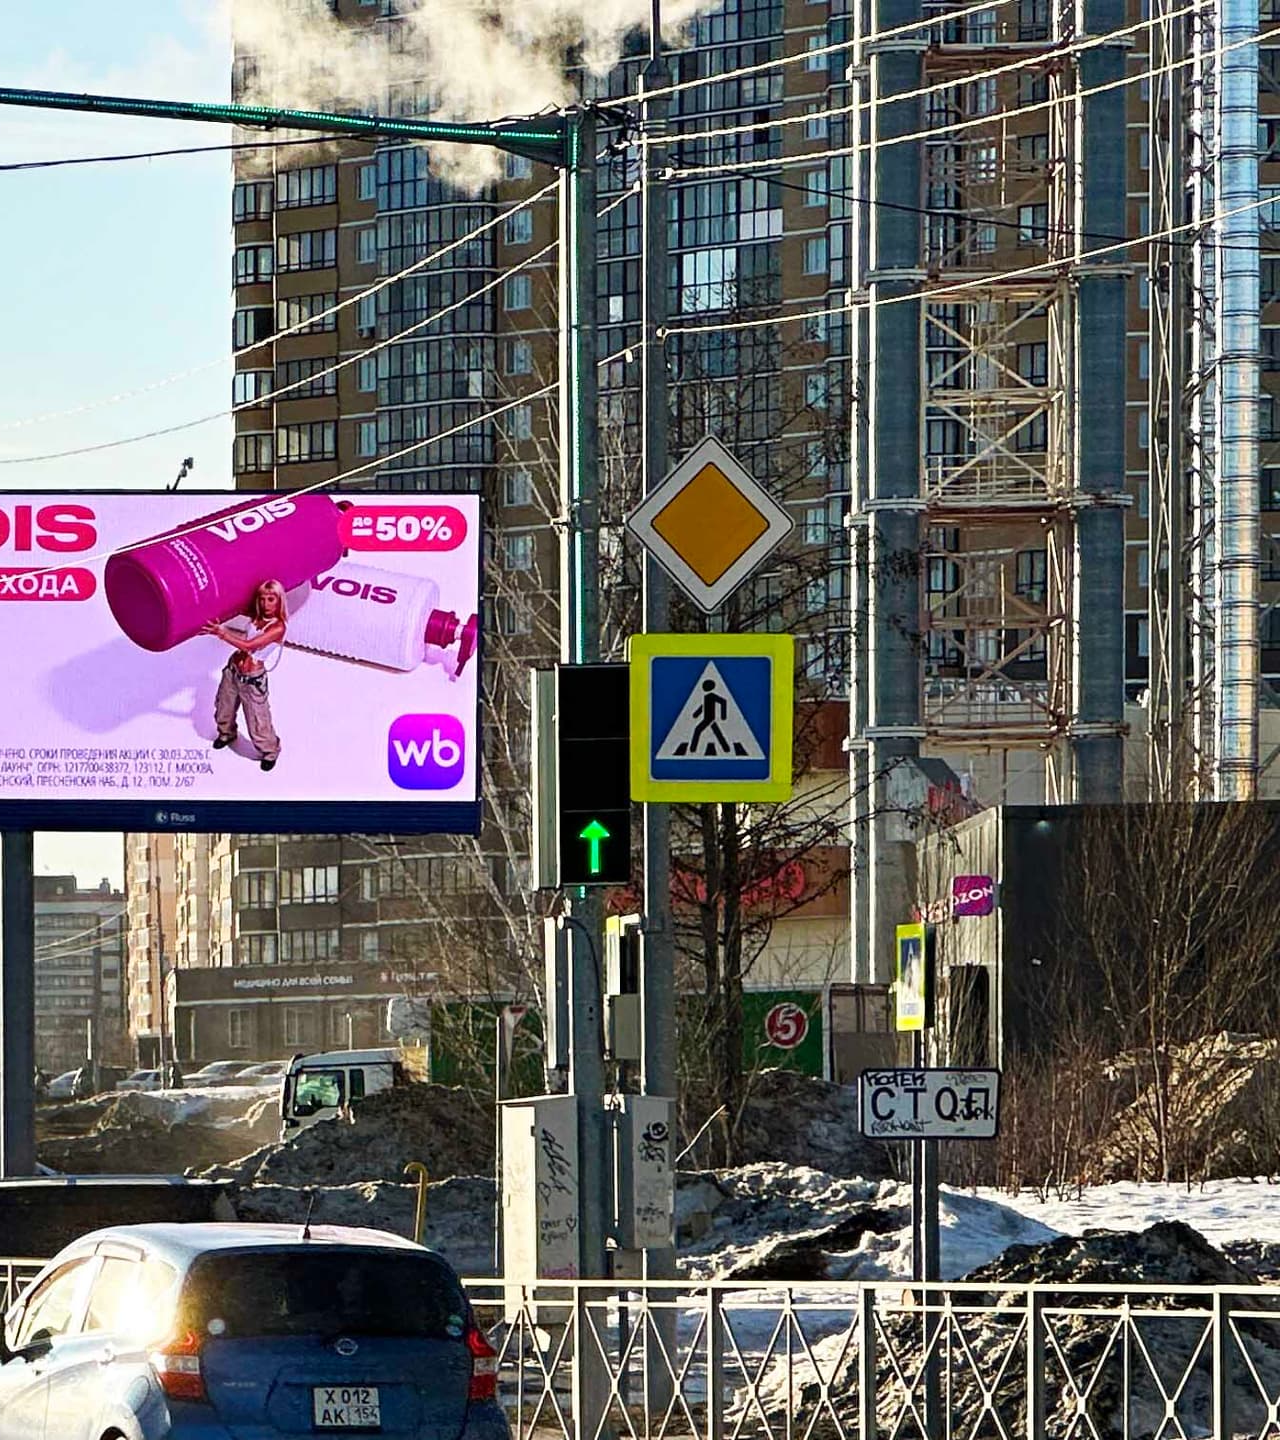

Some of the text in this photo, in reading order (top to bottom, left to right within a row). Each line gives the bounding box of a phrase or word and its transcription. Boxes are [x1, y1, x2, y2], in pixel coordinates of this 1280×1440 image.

[206, 499, 297, 543] VOIS
[310, 576, 398, 605] VOIS
[29, 748, 58, 760] СРОКИ
[60, 749, 117, 761] ПРОВЕДЕНИЯ
[119, 749, 149, 761] АКЦИИ
[393, 729, 461, 768] wb
[37, 775, 96, 787] ПРЕСНЕНСКАЯ
[774, 1008, 795, 1041] 5
[871, 1086, 990, 1121] СТОП
